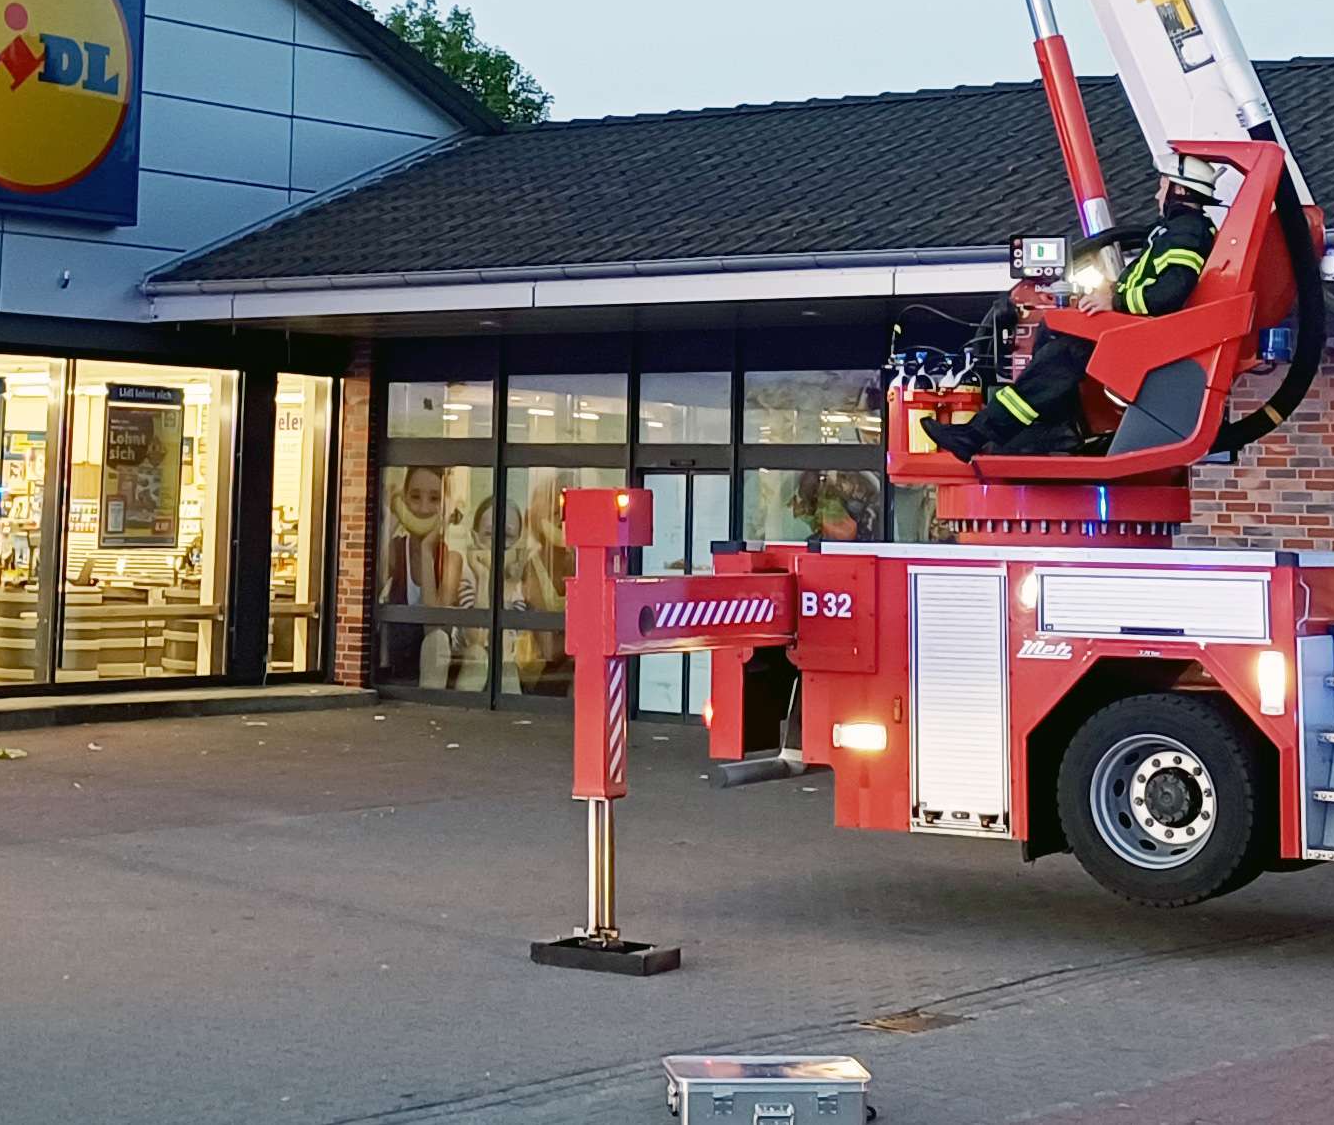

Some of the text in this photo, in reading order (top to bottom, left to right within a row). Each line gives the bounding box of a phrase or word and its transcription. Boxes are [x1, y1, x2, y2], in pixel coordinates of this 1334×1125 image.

[119, 387, 134, 398] Lidl
[110, 431, 146, 446] Lohnt
[109, 445, 136, 461] sich
[801, 592, 852, 618] B 32
